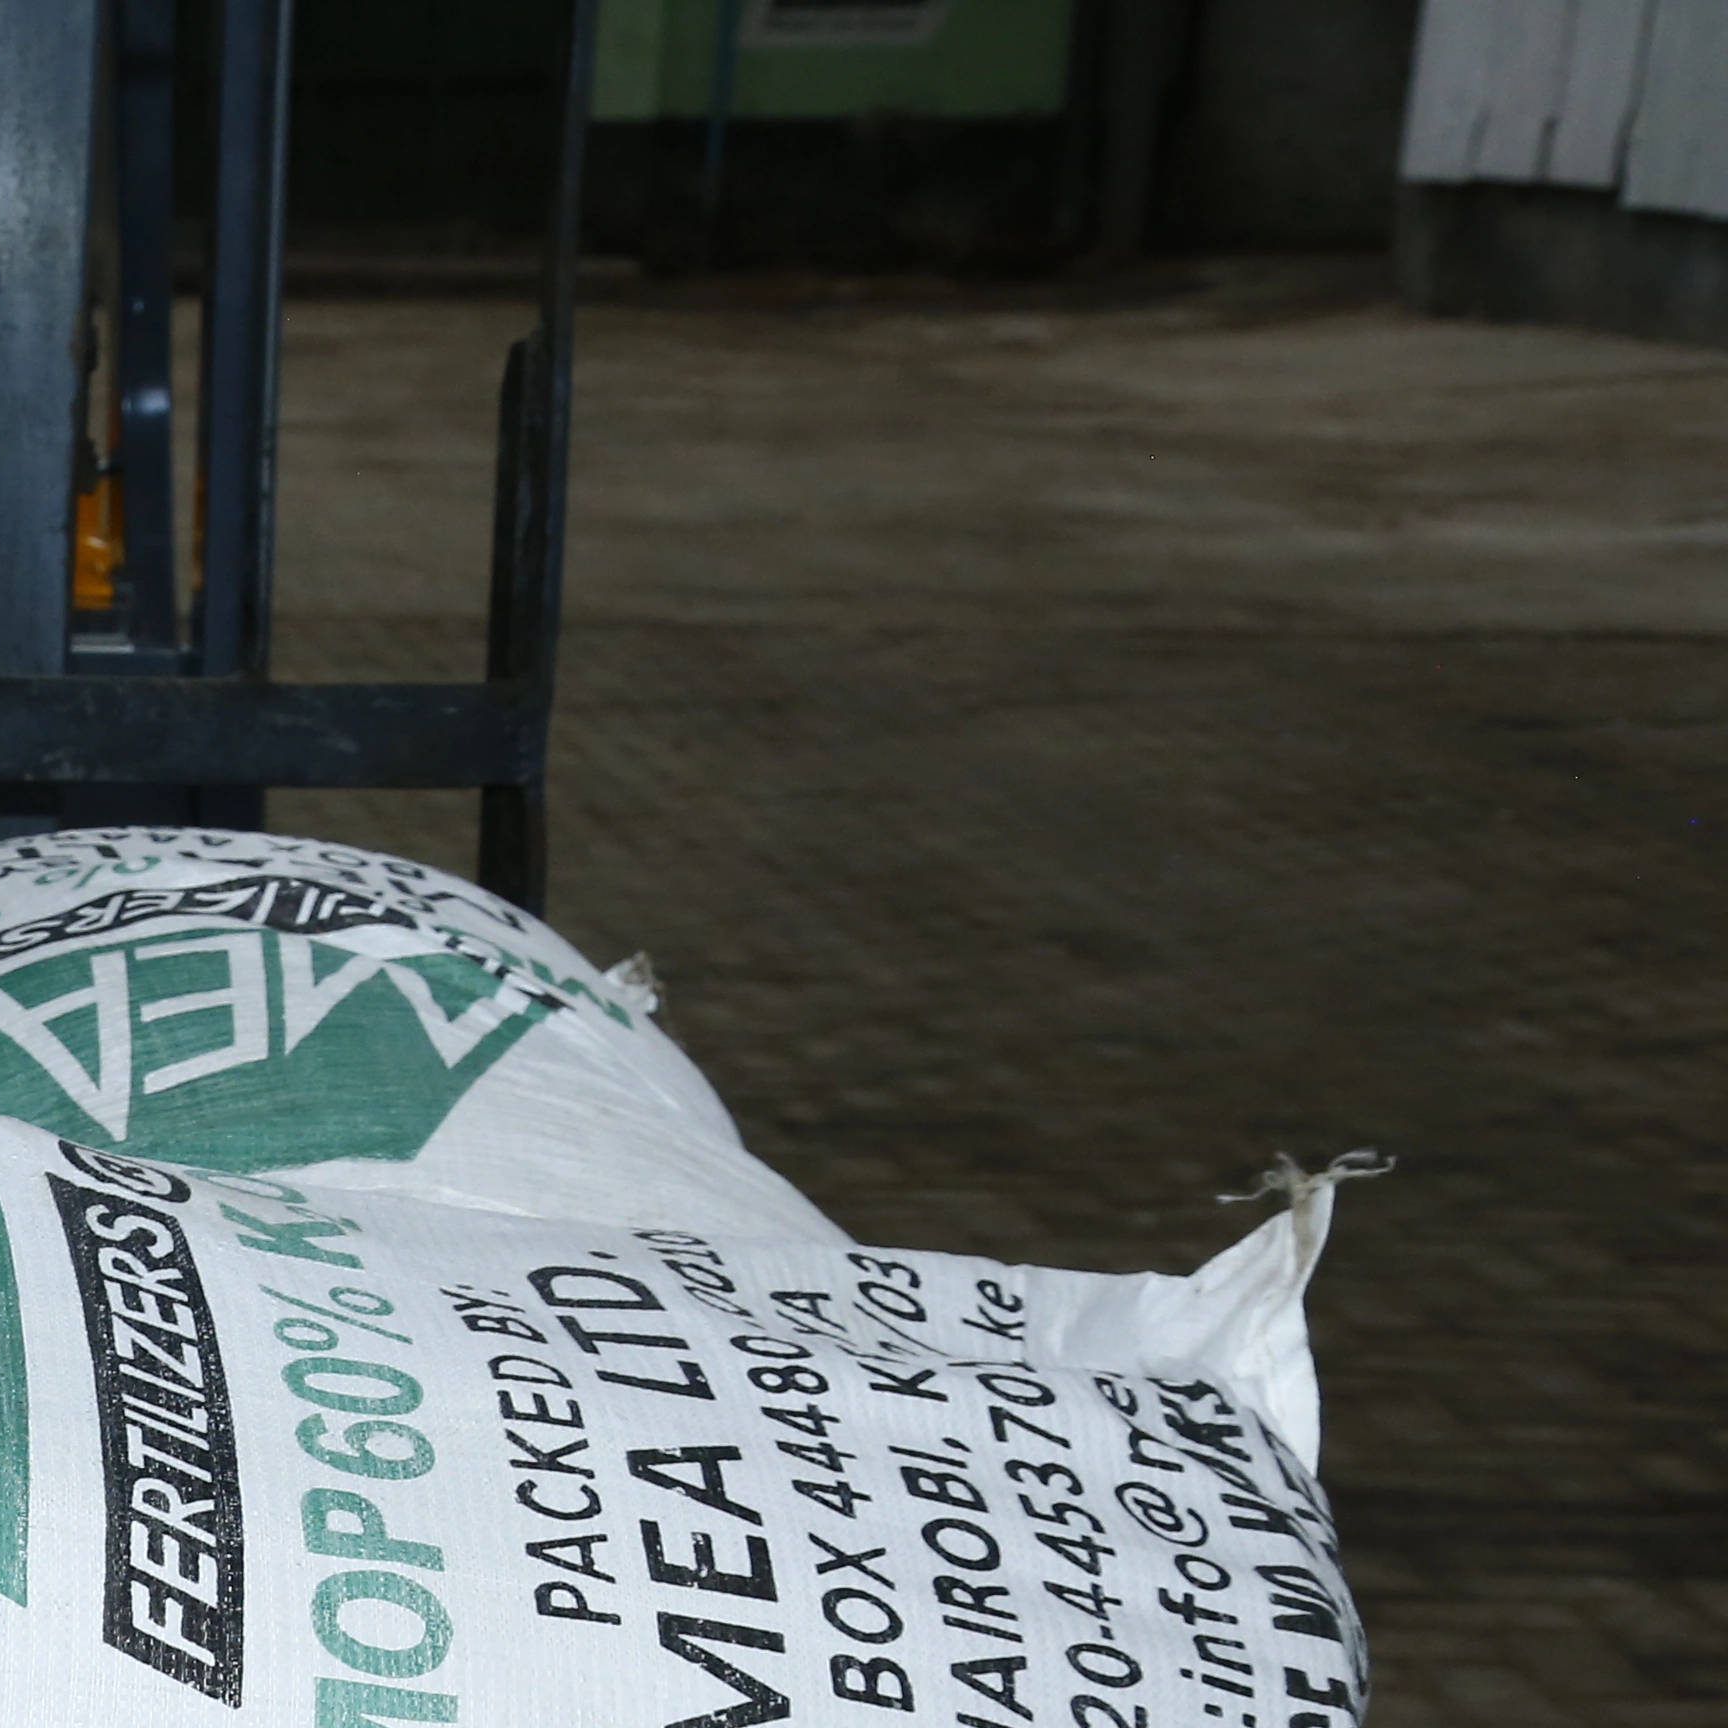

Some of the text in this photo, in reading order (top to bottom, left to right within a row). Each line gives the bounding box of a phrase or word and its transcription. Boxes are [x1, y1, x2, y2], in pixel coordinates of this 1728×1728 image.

[86, 1204, 219, 1667] FERTILIZERS
[439, 1282, 622, 1626] PACKED BY:
[526, 1249, 717, 1400] LTD.
[808, 1531, 916, 1712] BOX
